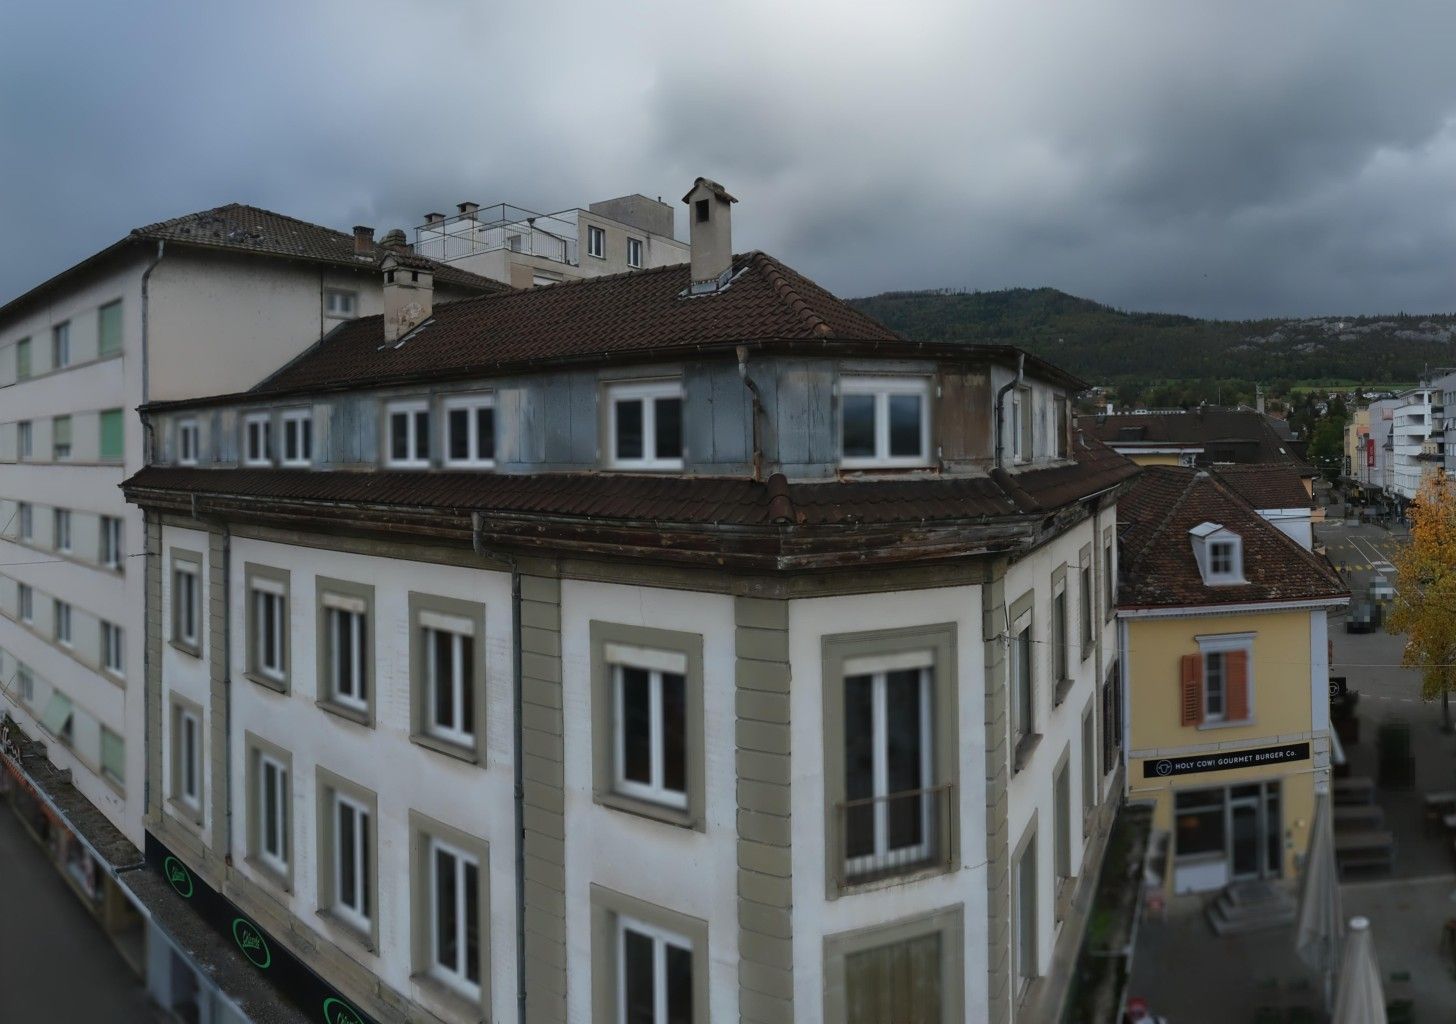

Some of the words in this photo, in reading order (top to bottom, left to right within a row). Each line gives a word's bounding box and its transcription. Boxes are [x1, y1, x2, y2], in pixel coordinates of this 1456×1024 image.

[1175, 761, 1194, 770] HOLY
[1196, 759, 1216, 768] COW!
[1218, 755, 1253, 766] GOURMET
[1255, 751, 1284, 761] BURGER
